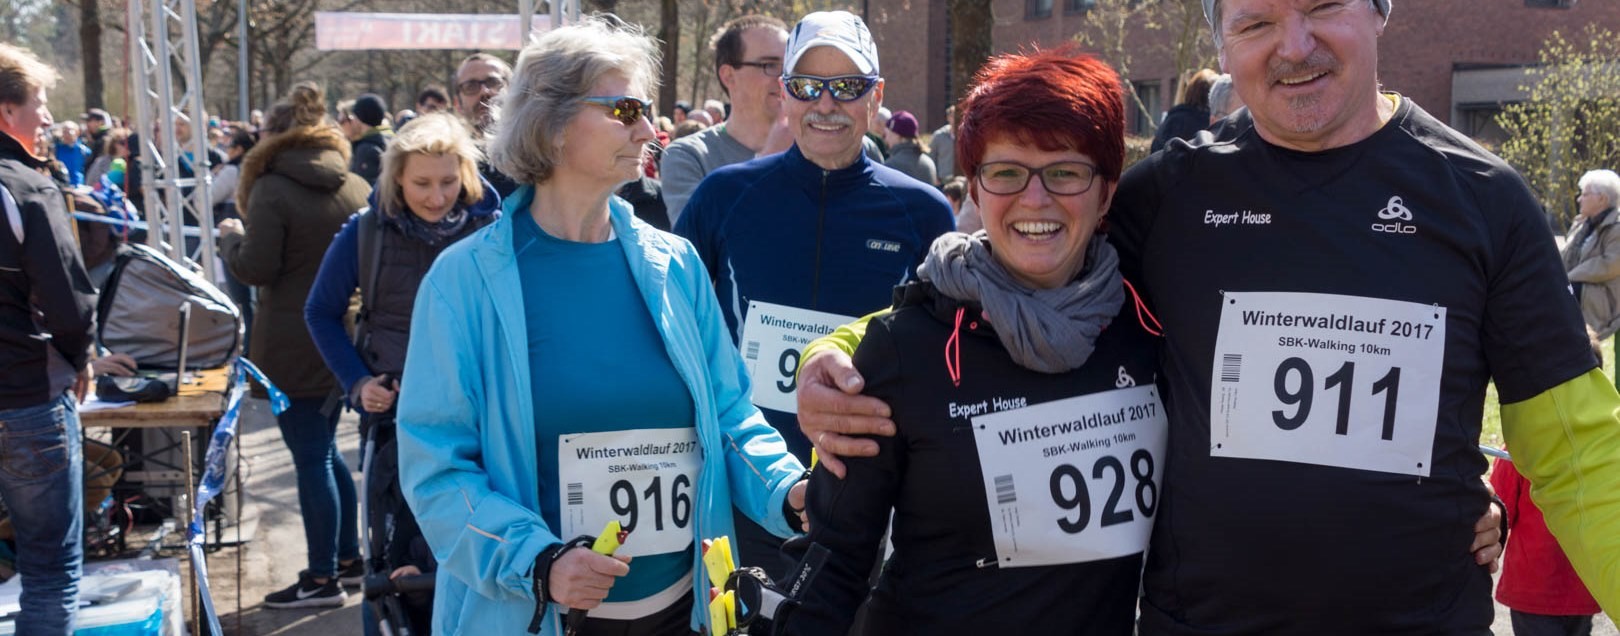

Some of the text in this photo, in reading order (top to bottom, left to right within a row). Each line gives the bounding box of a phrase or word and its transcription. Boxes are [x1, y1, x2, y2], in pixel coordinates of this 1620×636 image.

[1204, 209, 1272, 227] Expert House
[1371, 222, 1417, 234] odlo
[760, 314, 836, 335] Winterwaldla
[1242, 310, 1434, 340] Winterwaldlauf 2017
[1278, 336, 1391, 356] SBK-Walking 10km
[949, 396, 1028, 419] Expert House
[1271, 356, 1402, 441] 911
[998, 402, 1157, 446] Winterwaldlauf 2017
[576, 441, 697, 460] Winterwaldlauf 2017
[1042, 432, 1136, 457] SBK-Walking 10km
[608, 461, 677, 474] SBK-Walking 10km
[1049, 448, 1157, 535] 928
[609, 473, 691, 534] 916
